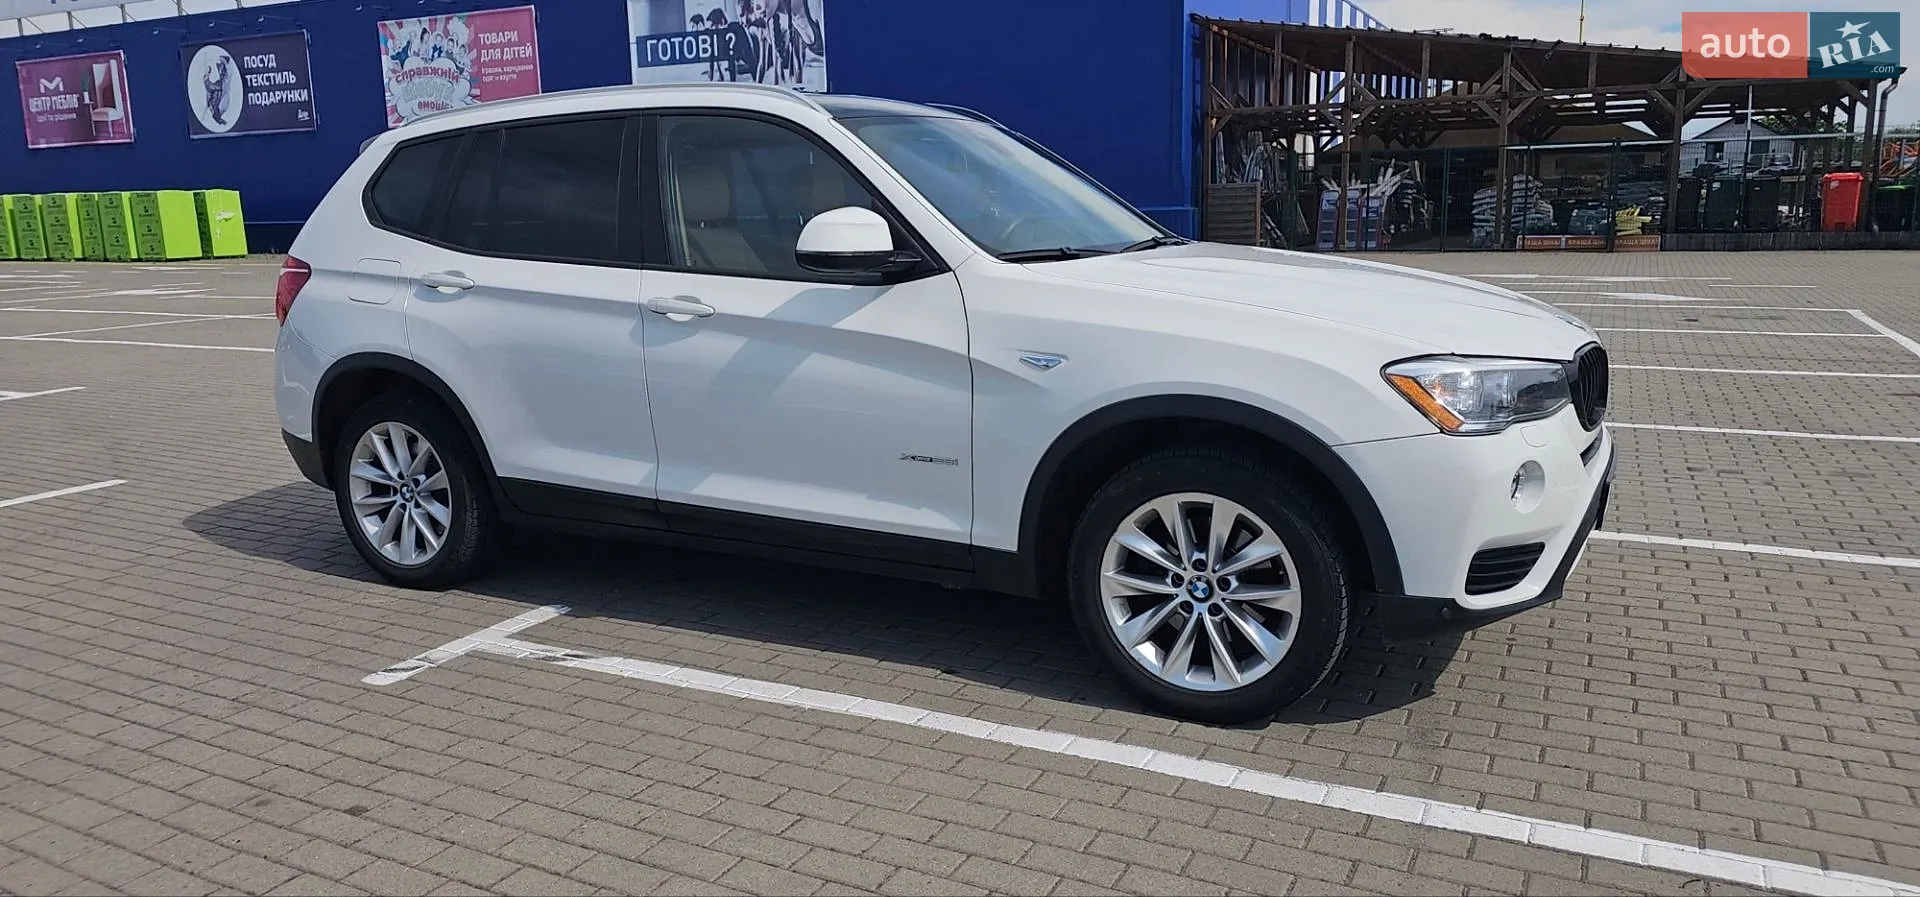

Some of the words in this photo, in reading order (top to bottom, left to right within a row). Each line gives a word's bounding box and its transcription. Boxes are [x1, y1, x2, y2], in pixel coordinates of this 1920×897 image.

[478, 30, 518, 45] ТОВАРИ
[480, 48, 501, 63] ДЛЯ
[503, 42, 533, 61] ДІТЕЙ
[646, 34, 718, 62] ГОТОВІ
[725, 32, 736, 56] ?
[243, 54, 277, 69] ПОСУД
[245, 71, 297, 87] ТЕКСТИЛЬ
[247, 88, 309, 107] ПОДАРУНКИ
